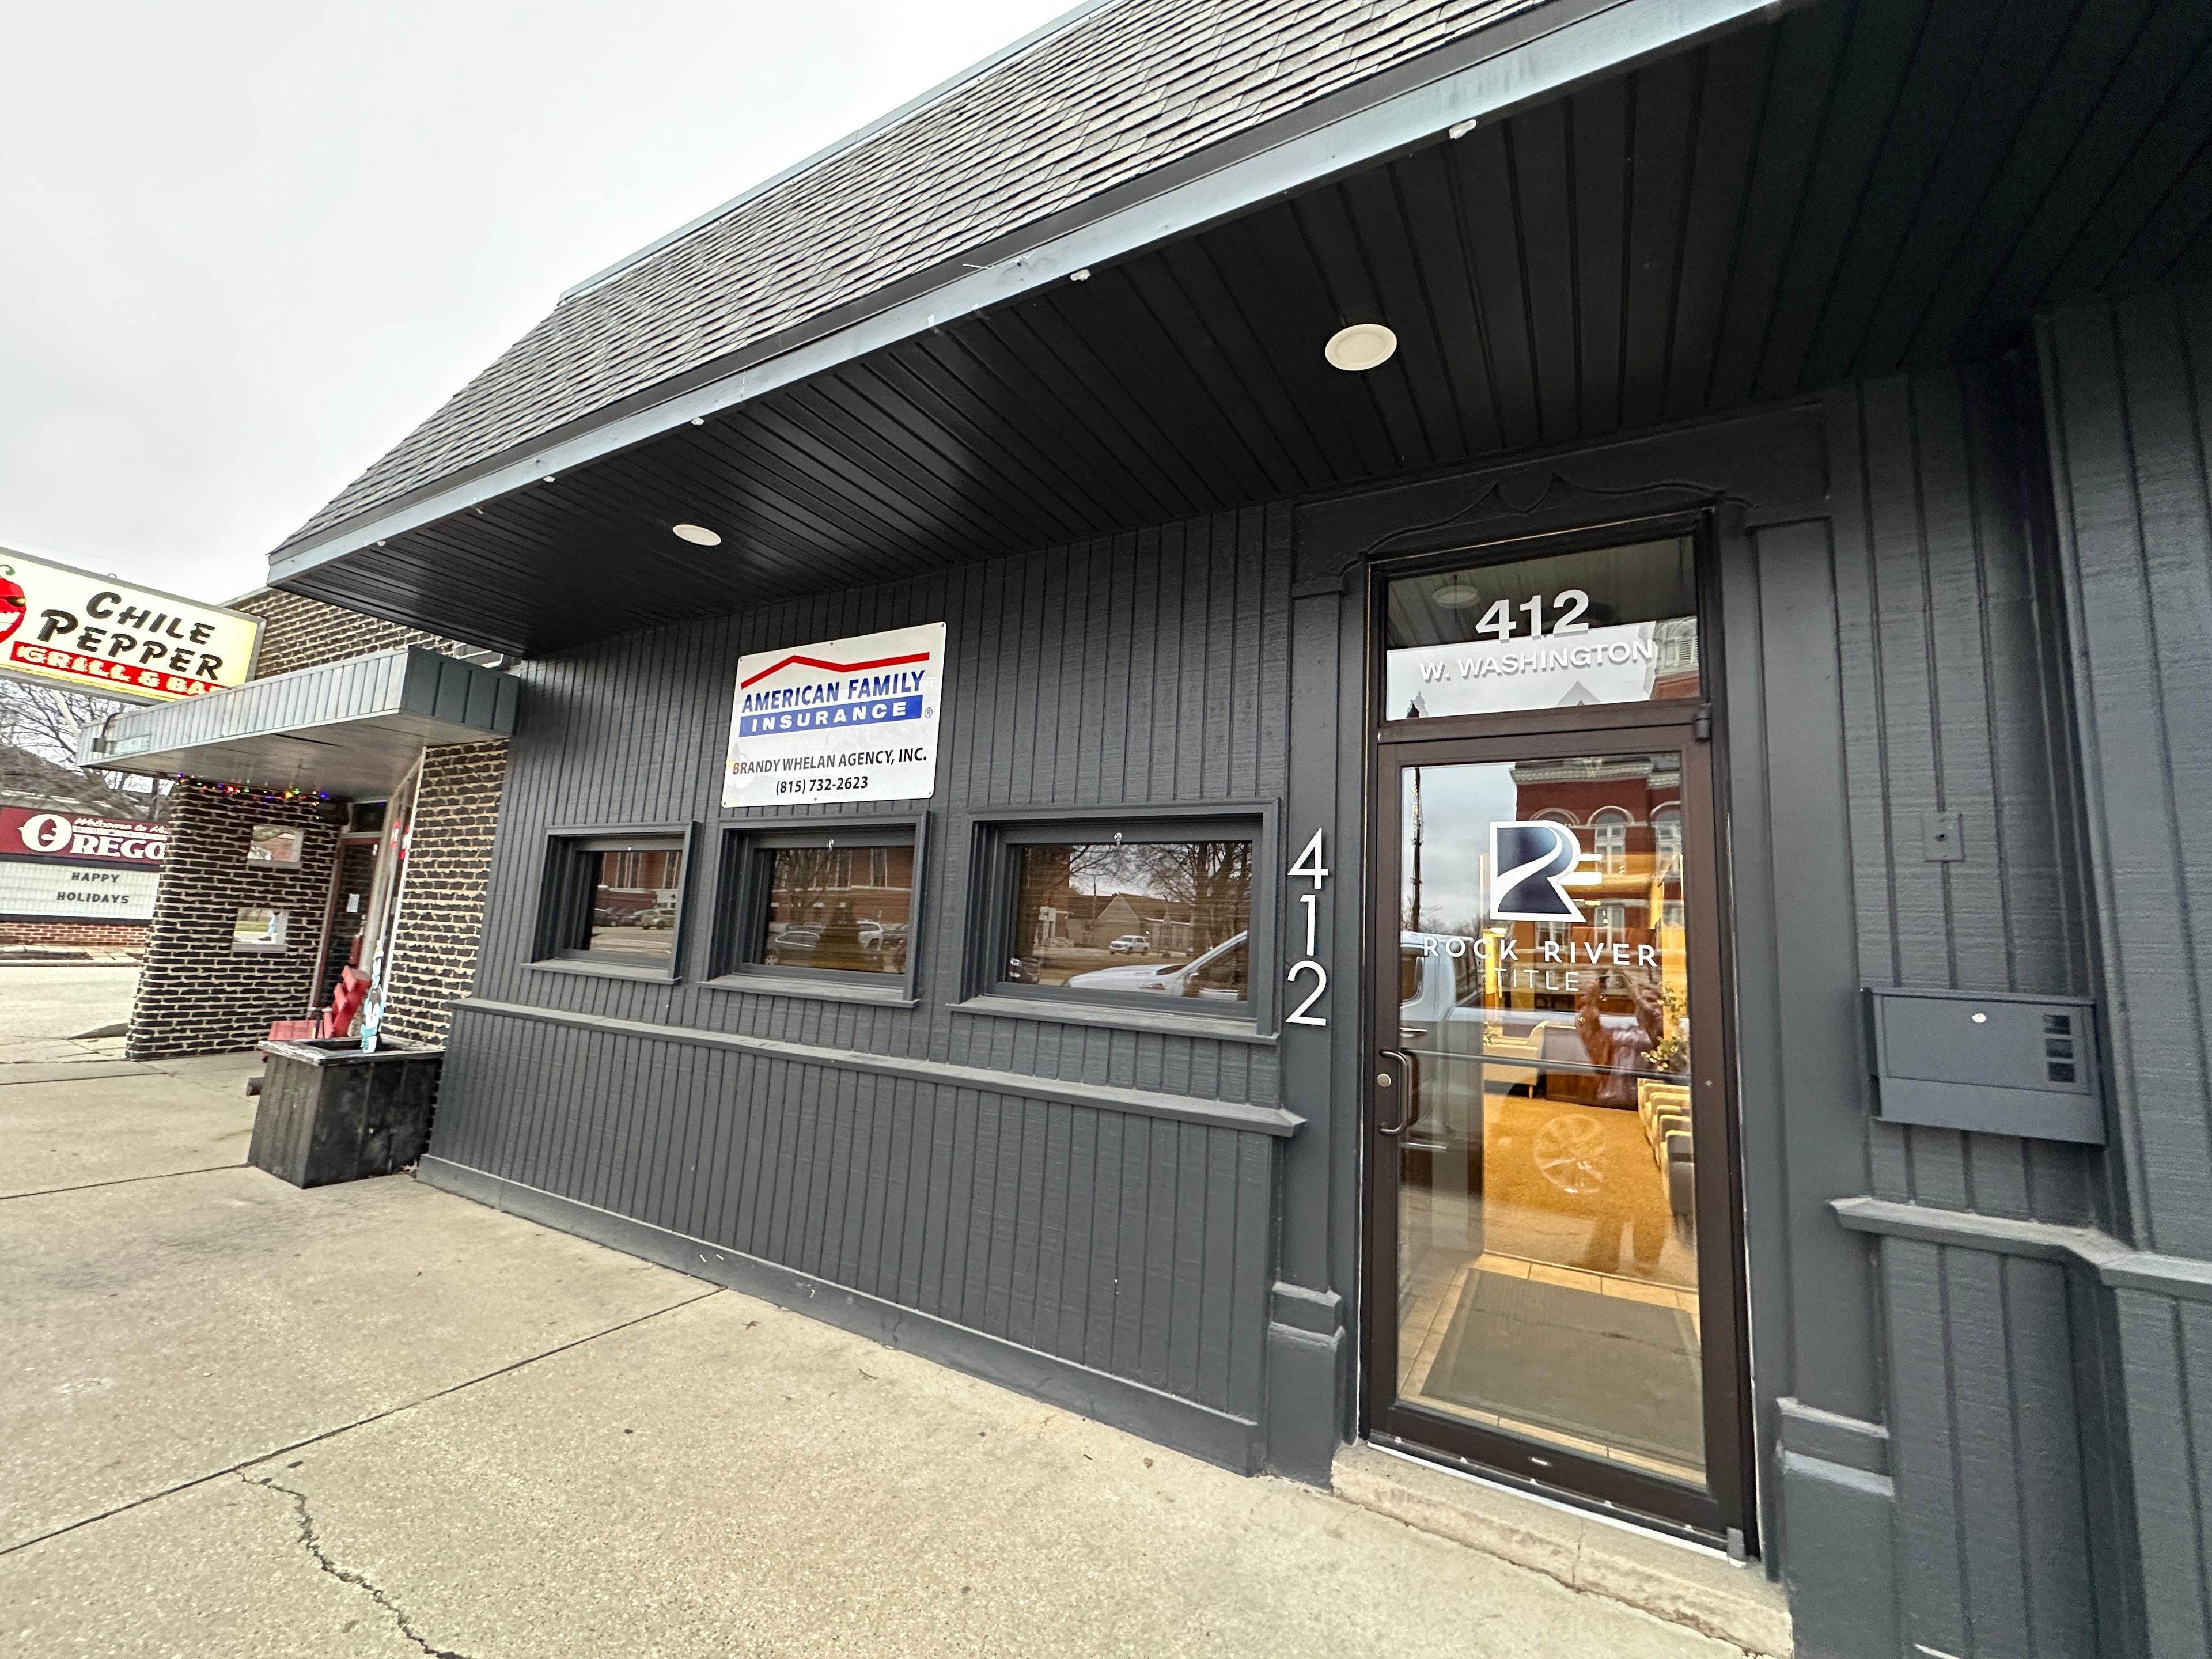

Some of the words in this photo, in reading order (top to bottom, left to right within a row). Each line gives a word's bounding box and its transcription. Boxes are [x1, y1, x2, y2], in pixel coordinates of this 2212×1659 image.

[86, 592, 215, 645] CHILE
[1475, 589, 1589, 641] 412
[37, 609, 223, 680] PEPPER
[1419, 660, 1451, 682] W.
[1457, 638, 1654, 679] WASHINGTON
[17, 645, 131, 683] GRILL
[137, 671, 161, 688] &
[741, 681, 840, 713] AMERICAN
[847, 669, 925, 699] FAMILY
[751, 701, 907, 732] INSURANCE
[733, 759, 780, 775] BRANDY
[783, 754, 835, 771] WHELAN
[838, 750, 895, 767] AGENCY,
[899, 747, 927, 762] INC.
[776, 780, 806, 796] (815)
[809, 776, 868, 792] 732-2623
[74, 817, 132, 830] Welcome
[71, 872, 120, 882] HAPPY
[57, 892, 130, 904] HOLIDAYS
[1423, 936, 1519, 961] ROCK
[1544, 941, 1657, 967] RIVER
[1494, 968, 1580, 992] TITLE
